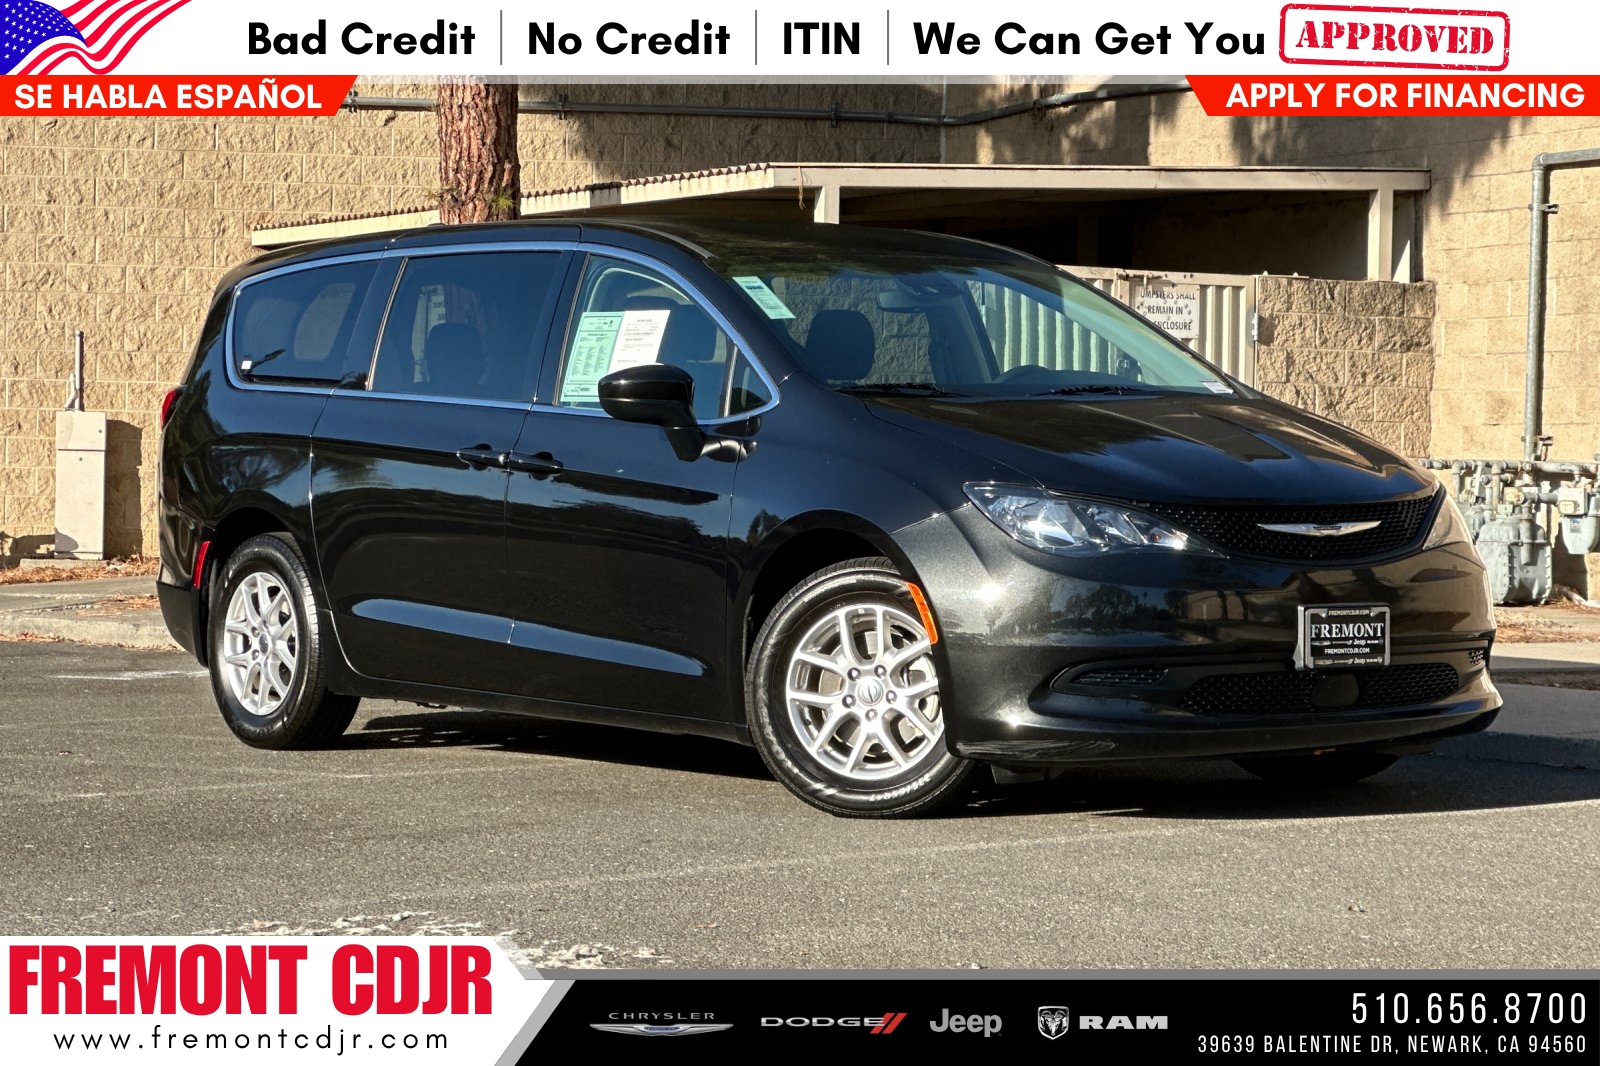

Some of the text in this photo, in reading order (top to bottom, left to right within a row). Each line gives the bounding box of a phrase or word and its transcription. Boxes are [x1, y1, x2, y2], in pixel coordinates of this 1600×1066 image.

[1140, 289, 1174, 300] UMPSTERS
[1147, 305, 1184, 315] REMAIN IN
[1311, 623, 1384, 638] FREMONT
[1324, 647, 1370, 655] FREMONTCDJR.COM
